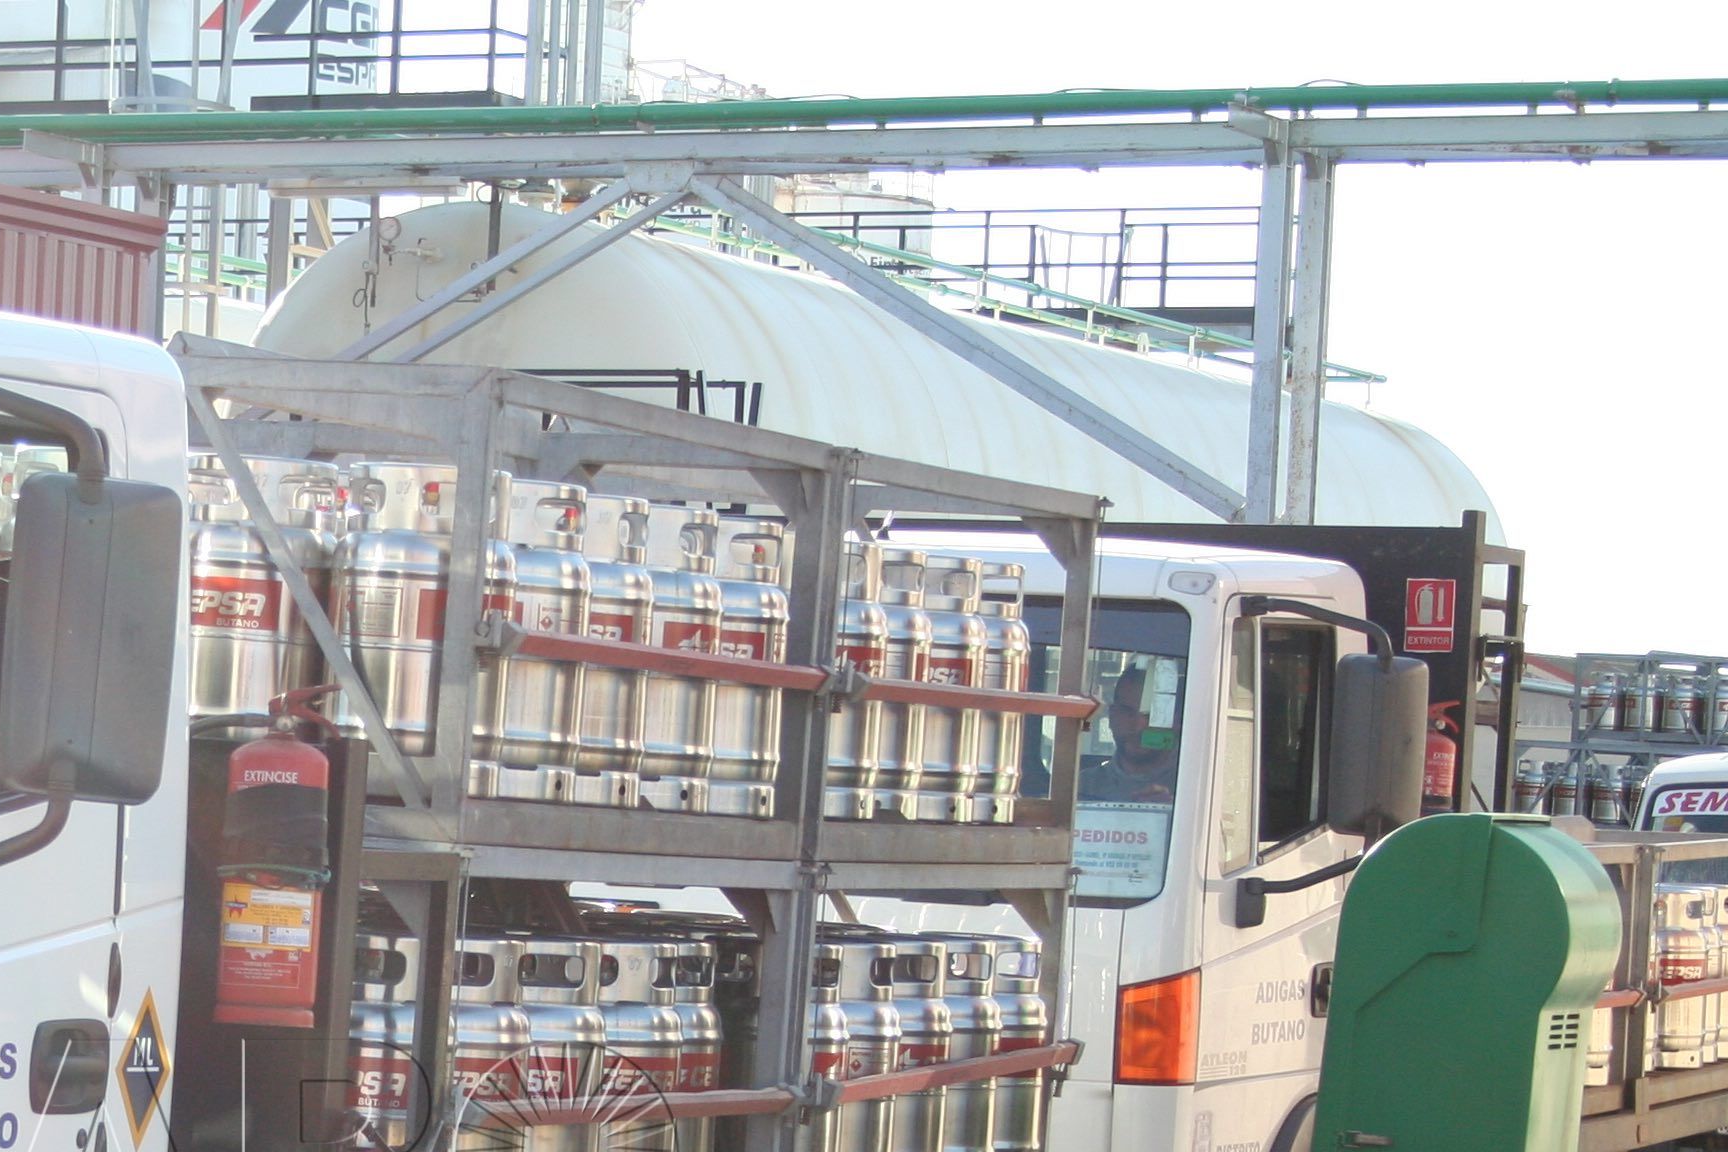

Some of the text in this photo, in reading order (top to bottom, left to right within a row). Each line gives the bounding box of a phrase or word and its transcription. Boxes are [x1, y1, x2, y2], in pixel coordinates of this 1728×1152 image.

[216, 617, 259, 628] BUTANO
[1407, 635, 1451, 646] EXTINTOR
[244, 770, 299, 784] EXTINCISE
[1658, 791, 1728, 816] SEM
[1072, 829, 1148, 844] PEDIDOS
[1255, 979, 1305, 1004] ADIGAS
[1251, 1019, 1305, 1045] BUTANO
[1200, 1050, 1247, 1068] ATLEON
